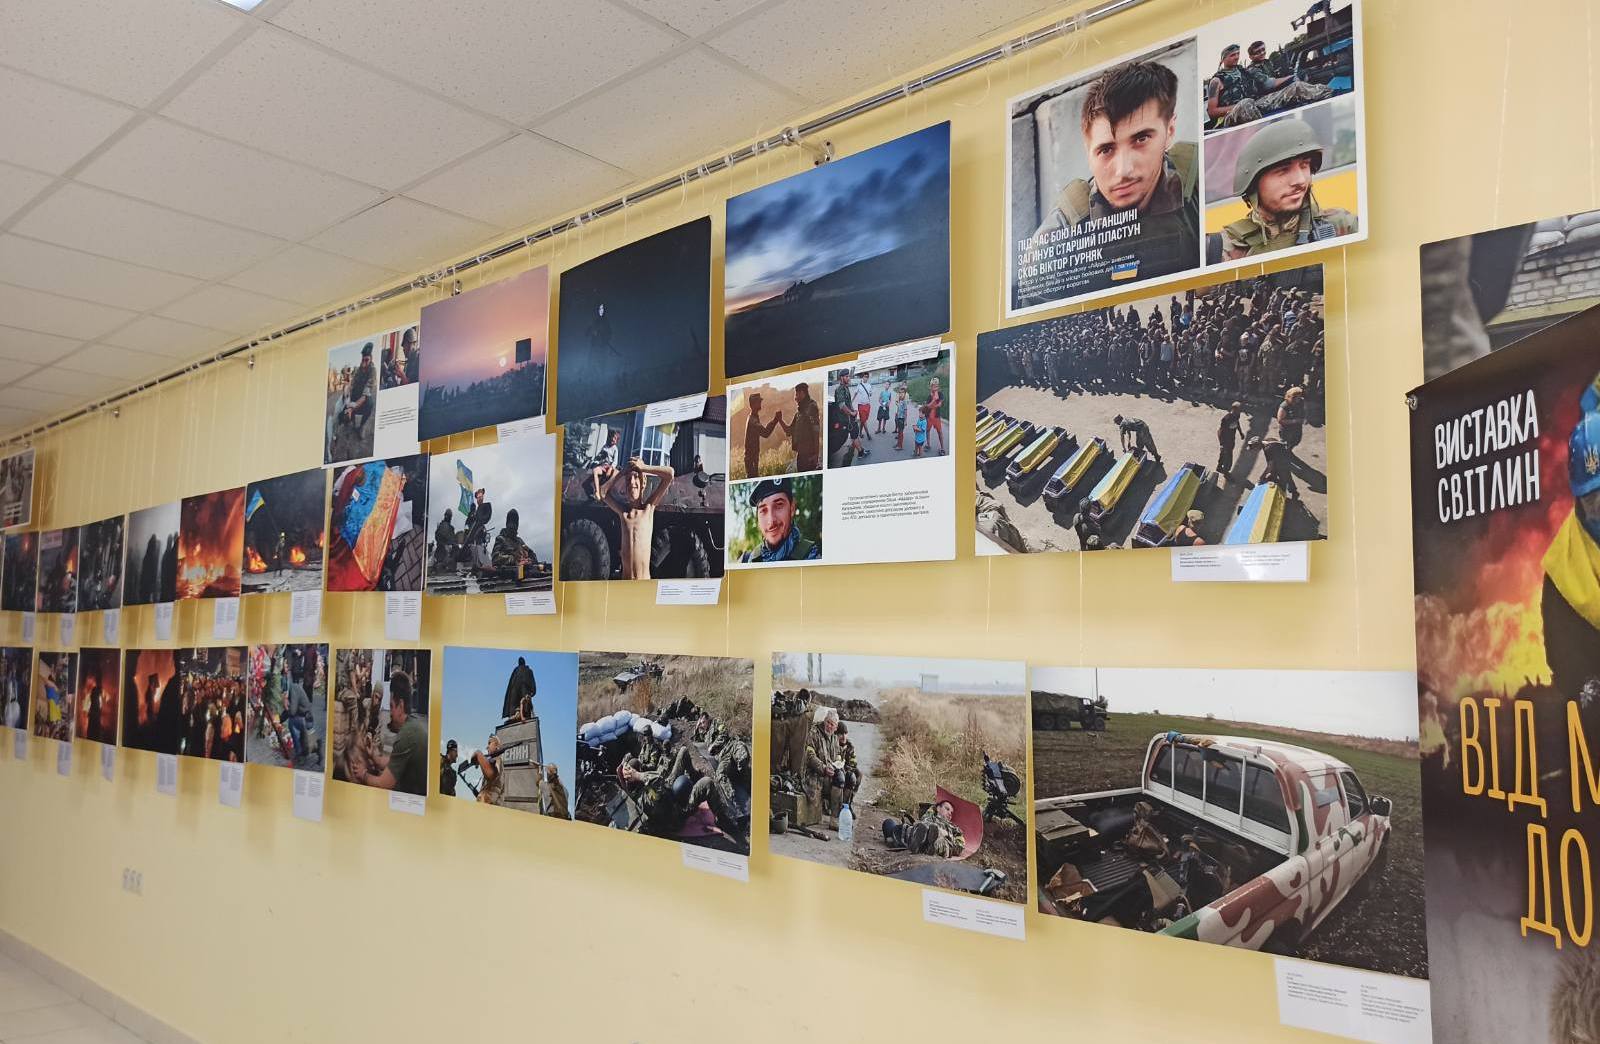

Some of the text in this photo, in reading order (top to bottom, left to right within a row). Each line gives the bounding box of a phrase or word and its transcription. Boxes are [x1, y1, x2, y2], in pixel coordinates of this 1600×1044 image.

[1018, 208, 1138, 252] ПІД ЧАС БОЮ НА ЛУГАНЩИНІ
[1018, 222, 1141, 266] ЗАГИНУВ СТАРШИЙ ПЛАСТУН
[1018, 248, 1103, 280] СКОБ ВІКТОР ГУРНЯК
[1435, 389, 1539, 470] ВИСТАВКА
[1438, 449, 1540, 523] СВІТЛИН
[1460, 696, 1547, 818] ВІД
[1520, 822, 1593, 950] ДО
